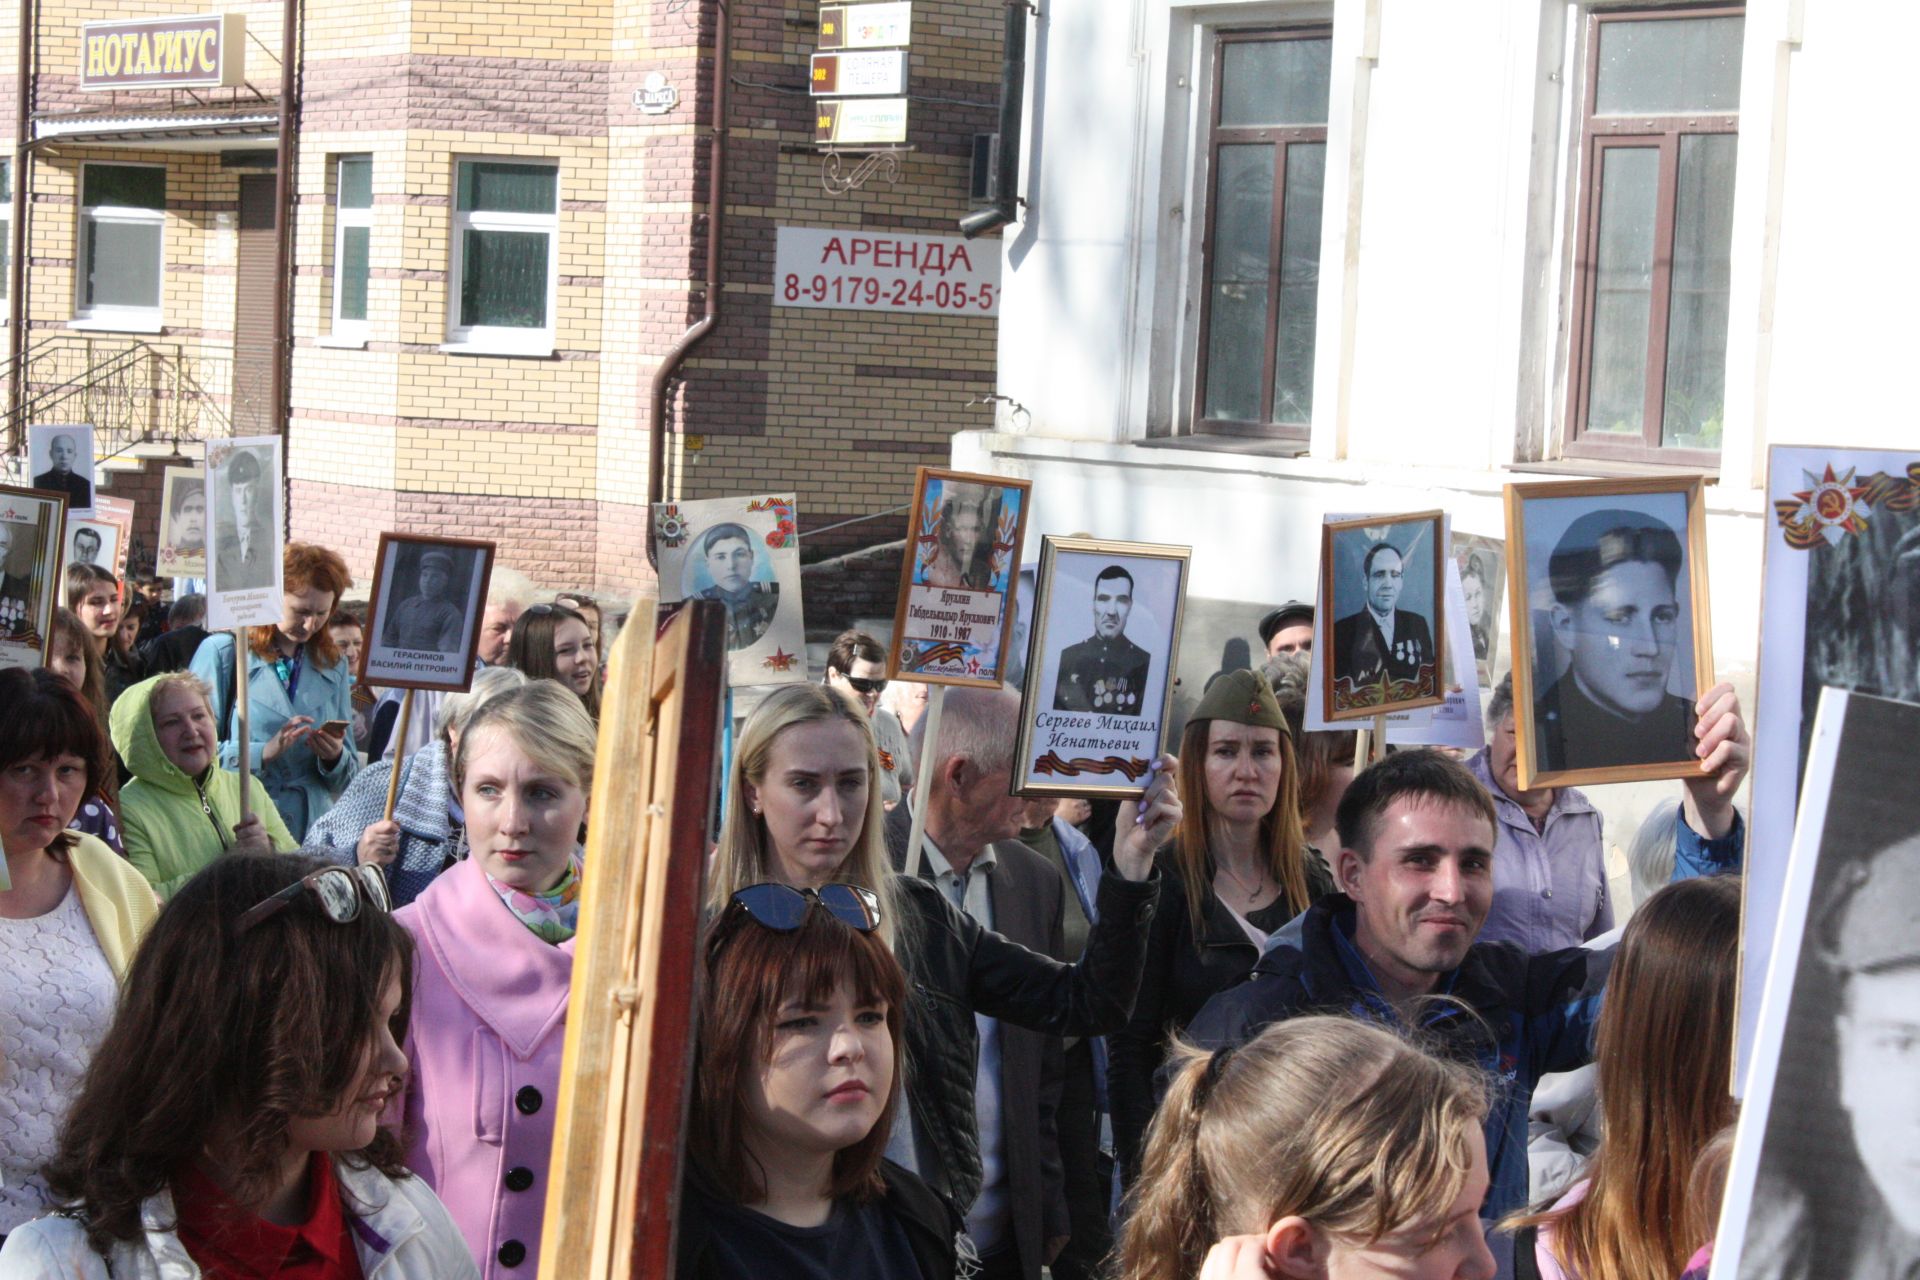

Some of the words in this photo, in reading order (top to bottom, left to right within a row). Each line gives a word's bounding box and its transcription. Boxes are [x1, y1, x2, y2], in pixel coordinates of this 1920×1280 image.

[86, 28, 217, 77] НОТАРИУС
[813, 68, 827, 81] 302
[821, 237, 973, 277] АРЕНДА
[940, 590, 971, 606] Яруллин
[930, 624, 947, 638] 1910
[954, 627, 972, 640] 1987
[393, 650, 445, 662] ГЕРАСИМОВ
[370, 659, 412, 670] ВАСИЛИЙ
[414, 663, 458, 673] ПЕТРОВИЧ
[1035, 712, 1092, 732] Сергеев
[1095, 715, 1157, 734] Михаил
[1046, 732, 1140, 750] Игнатьевич
